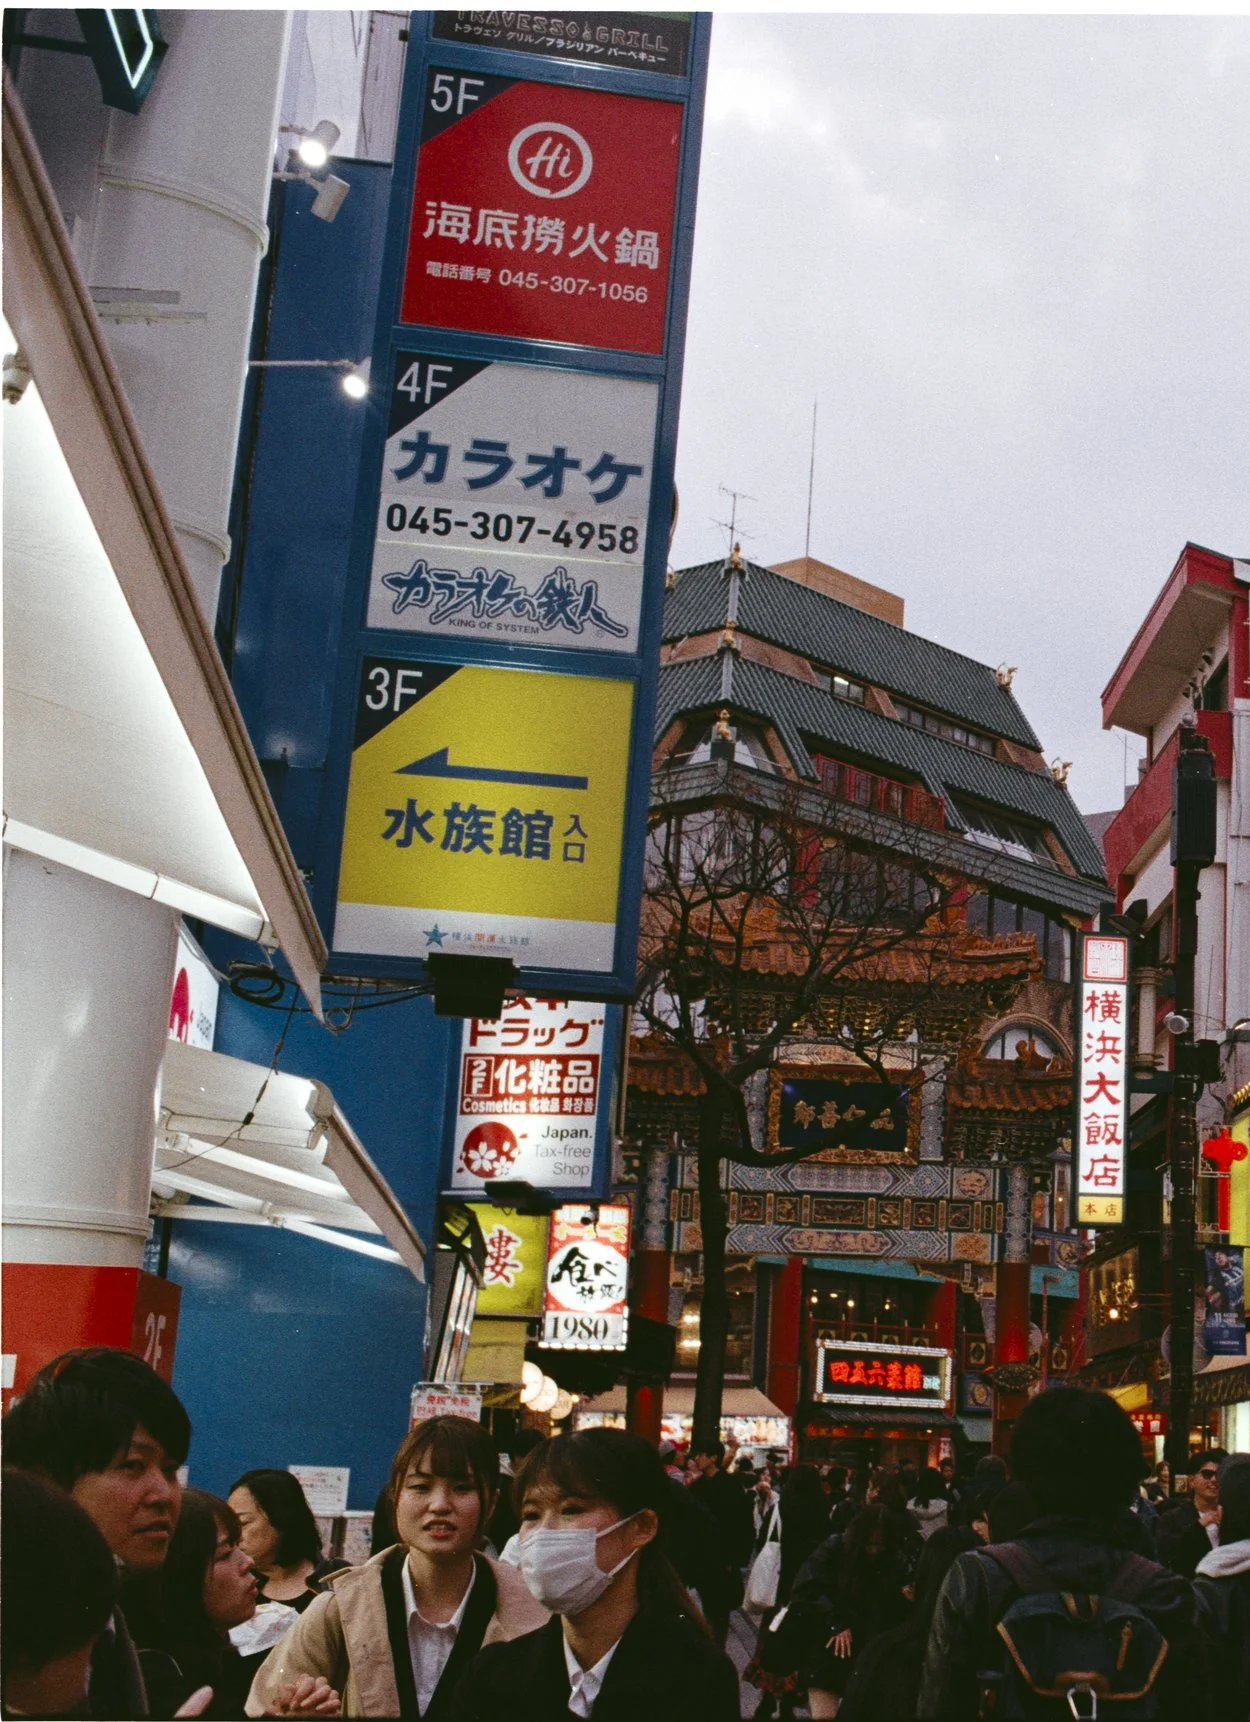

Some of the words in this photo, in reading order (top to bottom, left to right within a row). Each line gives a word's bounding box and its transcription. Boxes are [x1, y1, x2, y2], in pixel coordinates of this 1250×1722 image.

[596, 26, 669, 53] GRILL
[431, 74, 485, 115] 5F
[526, 136, 574, 179] Hi
[423, 201, 659, 270] 海底撈火鍋
[426, 261, 492, 284] 電話番号
[498, 269, 648, 303] 045-307-1056
[397, 362, 454, 405] 4F
[391, 432, 642, 502] カラオケ
[386, 503, 639, 554] 045-307-4958
[382, 560, 629, 638] カラオケの鉄人
[449, 618, 476, 630] KING
[478, 620, 492, 631] OF
[496, 622, 540, 634] SYSTEM
[365, 667, 423, 712] 3F
[381, 799, 554, 860] 水族館
[562, 814, 588, 863] 入口
[470, 1017, 604, 1047] ドラッグ
[470, 1059, 488, 1095] 2F
[494, 1058, 594, 1095] 化粧品
[1082, 990, 1122, 1187] 横浜大飯店
[462, 1098, 526, 1113] Cosmetics
[533, 1144, 592, 1158] Tax-free
[541, 1126, 593, 1141] Japan.
[552, 1161, 590, 1178] Shop
[1084, 1203, 1117, 1217] 本店
[552, 1316, 608, 1341] 1980
